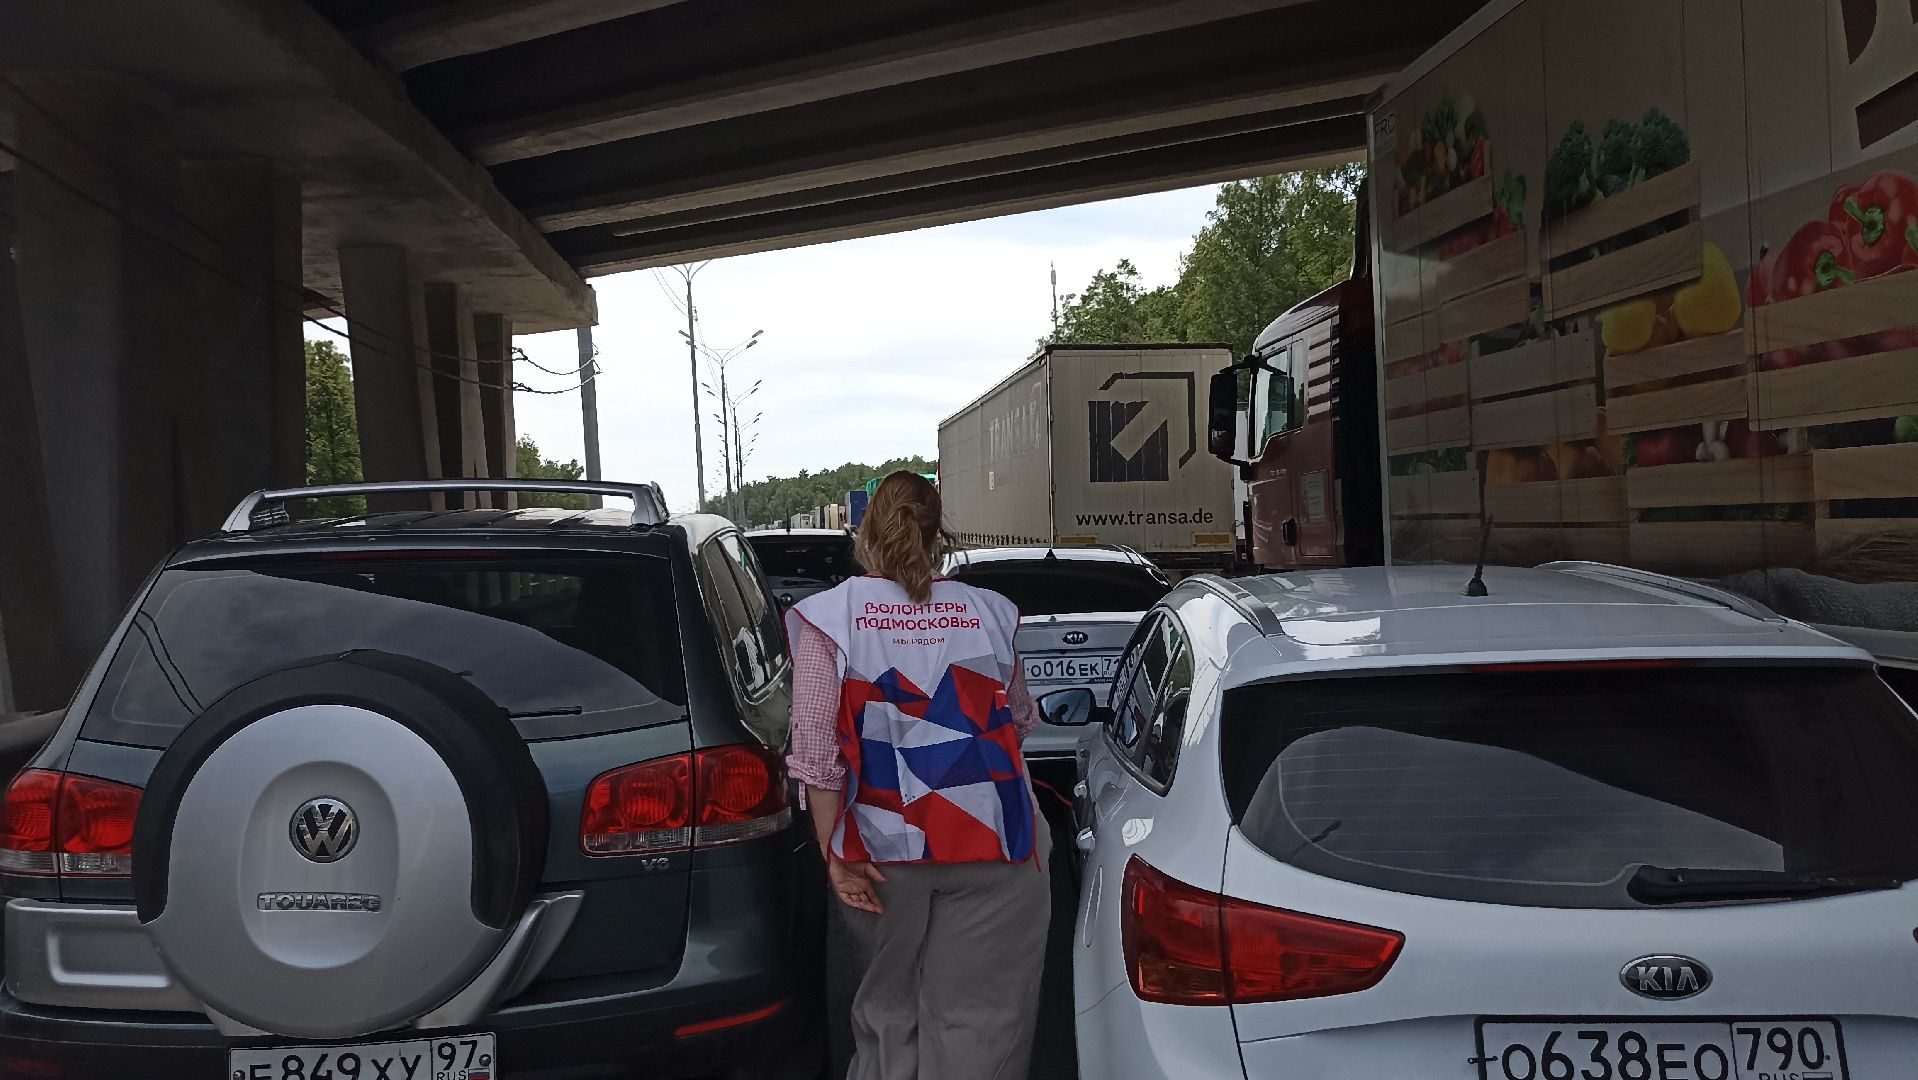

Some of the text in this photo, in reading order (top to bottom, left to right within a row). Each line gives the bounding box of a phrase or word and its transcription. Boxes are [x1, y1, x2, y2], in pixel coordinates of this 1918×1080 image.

[1075, 507, 1214, 526] www.transa.de
[864, 601, 968, 616] ВОЛОНТЕРЫ
[855, 616, 982, 631] ПОДМОСКОВЬЯ
[259, 893, 381, 912] TOUAREG
[1636, 966, 1700, 991] KIA
[437, 1039, 478, 1069] 97
[1736, 1026, 1824, 1070] 790
